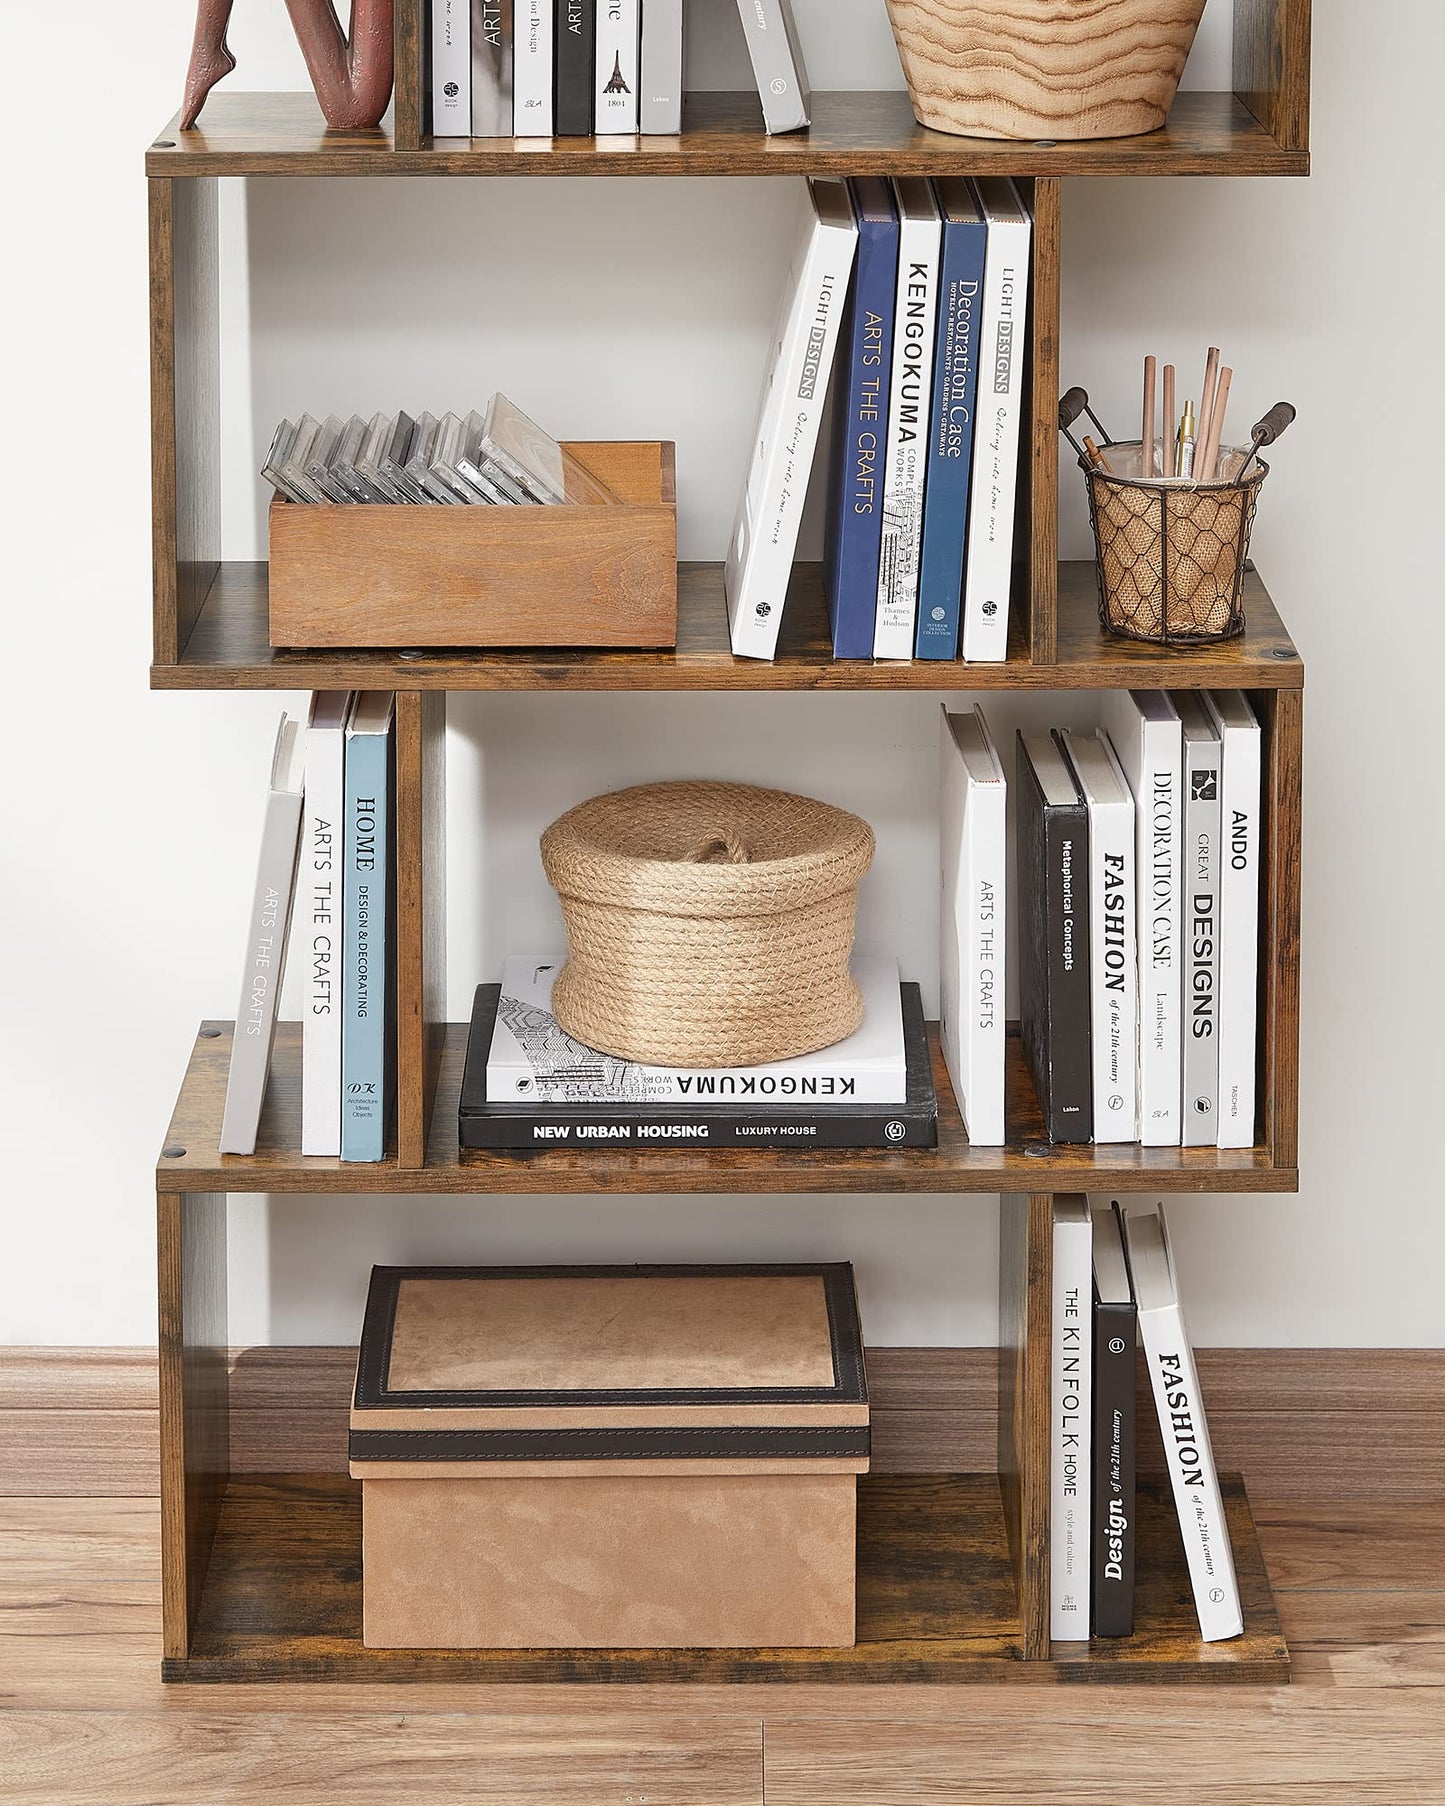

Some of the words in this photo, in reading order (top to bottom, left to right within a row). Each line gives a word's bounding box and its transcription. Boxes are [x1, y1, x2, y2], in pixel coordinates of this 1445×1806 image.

[529, 18, 541, 53] Design
[568, 0, 582, 34] ART
[815, 274, 835, 325] LIGHT
[948, 282, 957, 312] HOTELS
[1001, 268, 1014, 319] LIGHT
[862, 310, 883, 366] ARTS
[898, 263, 928, 444] KENGOKUMA
[944, 317, 954, 370] RESTAURANTS
[951, 279, 979, 400] Decoration
[995, 321, 1012, 393] DESIGNS
[799, 326, 825, 399] DESIGNS
[859, 377, 880, 421] THE
[941, 377, 950, 412] GARDENS
[938, 417, 947, 457] GETAWAYS
[947, 407, 970, 458] Case
[783, 462, 795, 483] into
[854, 432, 877, 514] CRAFTS
[895, 448, 906, 487] WORKS
[904, 448, 917, 507] COMPLETE
[992, 457, 1003, 479] into
[779, 488, 791, 513] home
[990, 484, 1001, 510] home
[772, 518, 782, 545] work
[988, 516, 1000, 543] work
[882, 620, 910, 628] Hudson
[883, 607, 910, 615] Thames
[314, 818, 332, 870] ARTS
[356, 797, 375, 872] HOME
[1153, 772, 1172, 912] DECORATION
[1231, 810, 1248, 870] ANDO
[1061, 840, 1074, 914] Metaphorical
[1198, 833, 1210, 882] GREAT
[261, 886, 279, 928] ARTS
[313, 882, 331, 924] THE
[358, 886, 368, 928] DESIGN
[980, 881, 994, 920] ARTS
[358, 931, 368, 940] &
[1104, 853, 1125, 993] FASHION
[1152, 917, 1172, 969] CASE
[255, 936, 273, 968] THE
[980, 929, 993, 961] THE
[1063, 918, 1074, 971] Concepts
[313, 936, 331, 1015] CRAFTS
[357, 943, 368, 1018] DECORATING
[1193, 894, 1213, 1039] DESIGNS
[247, 975, 268, 1036] CRAFTS
[980, 969, 993, 1029] CRAFTS
[1109, 999, 1120, 1010] of
[1111, 1012, 1120, 1027] the
[1110, 1028, 1120, 1047] 21th
[1154, 993, 1167, 1050] Landscape
[633, 1075, 672, 1084] WORKS
[677, 1076, 856, 1095] KENGOKUMA
[1109, 1050, 1119, 1084] century
[533, 1126, 570, 1138] NEW
[576, 1125, 631, 1138] URBAN
[637, 1125, 709, 1138] HOUSING
[735, 1126, 778, 1135] LUXURY
[780, 1126, 817, 1135] HOUSE
[1065, 1288, 1078, 1318] THE
[1062, 1327, 1080, 1448] KINFOLK
[1112, 1409, 1123, 1443] century
[1158, 1353, 1205, 1487] FASHION
[1064, 1454, 1077, 1497] HOME
[1110, 1464, 1121, 1479] the
[1110, 1481, 1122, 1493] of
[1065, 1509, 1073, 1529] style
[1191, 1494, 1202, 1504] of
[1195, 1506, 1205, 1520] the
[1104, 1498, 1128, 1581] Design
[1202, 1543, 1215, 1577] century
